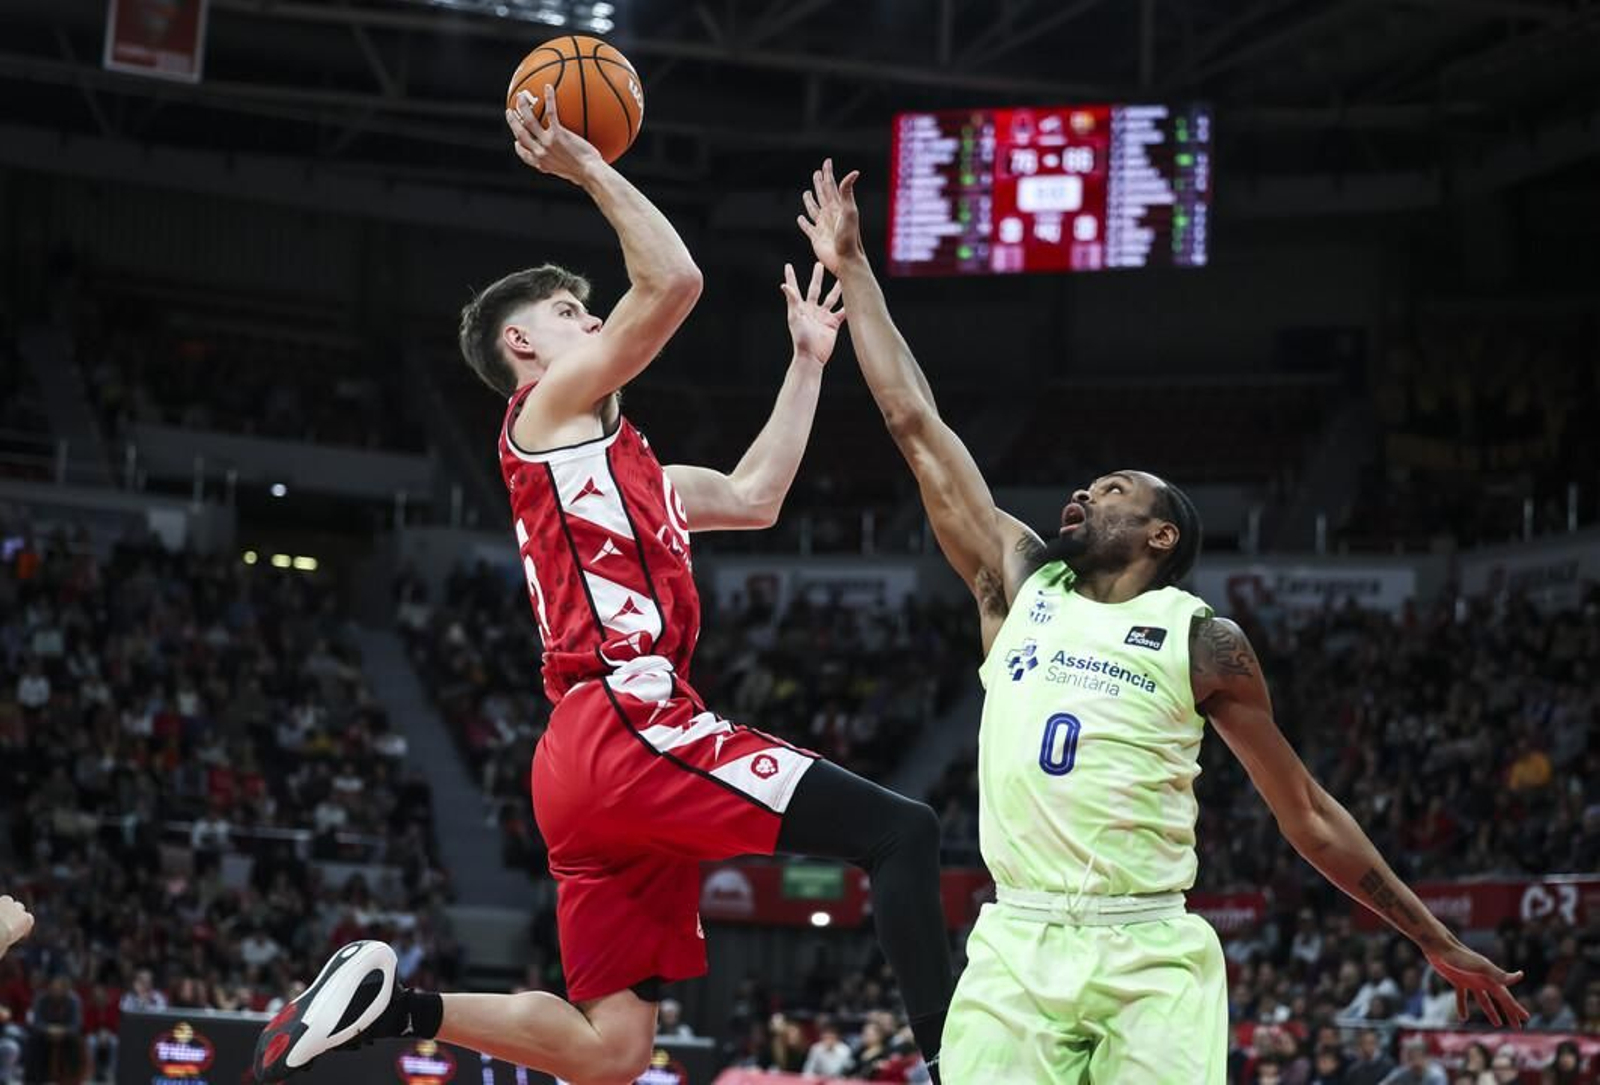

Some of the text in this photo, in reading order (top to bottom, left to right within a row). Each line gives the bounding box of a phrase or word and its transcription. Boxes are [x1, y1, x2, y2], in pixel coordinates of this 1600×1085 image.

[1045, 665, 1120, 697] Sanitària
[1050, 650, 1157, 694] Assistència
[1039, 712, 1082, 777] 0
